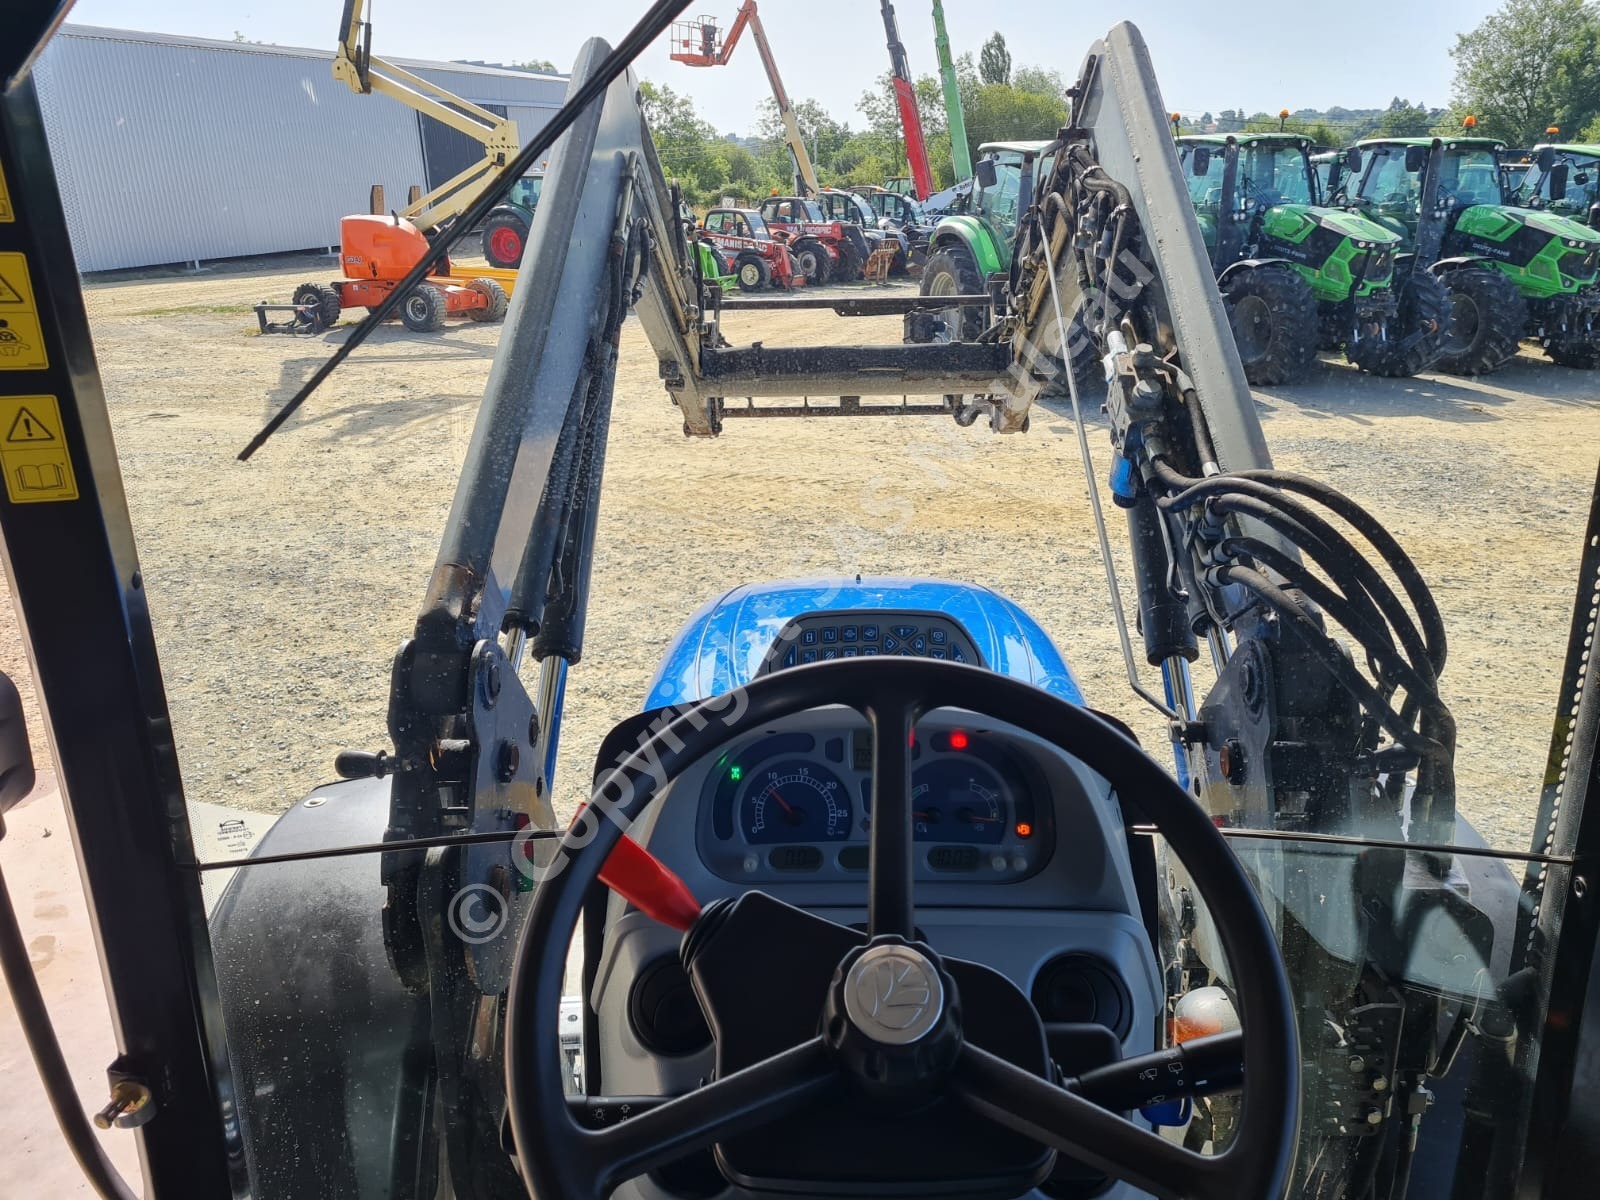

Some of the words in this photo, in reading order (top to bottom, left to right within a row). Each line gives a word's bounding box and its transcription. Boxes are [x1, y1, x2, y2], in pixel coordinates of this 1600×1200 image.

[767, 771, 778, 780] 10
[798, 767, 809, 776] 15
[826, 781, 838, 790] 20
[751, 796, 758, 804] 5
[837, 809, 848, 818] 25
[751, 826, 758, 834] 0
